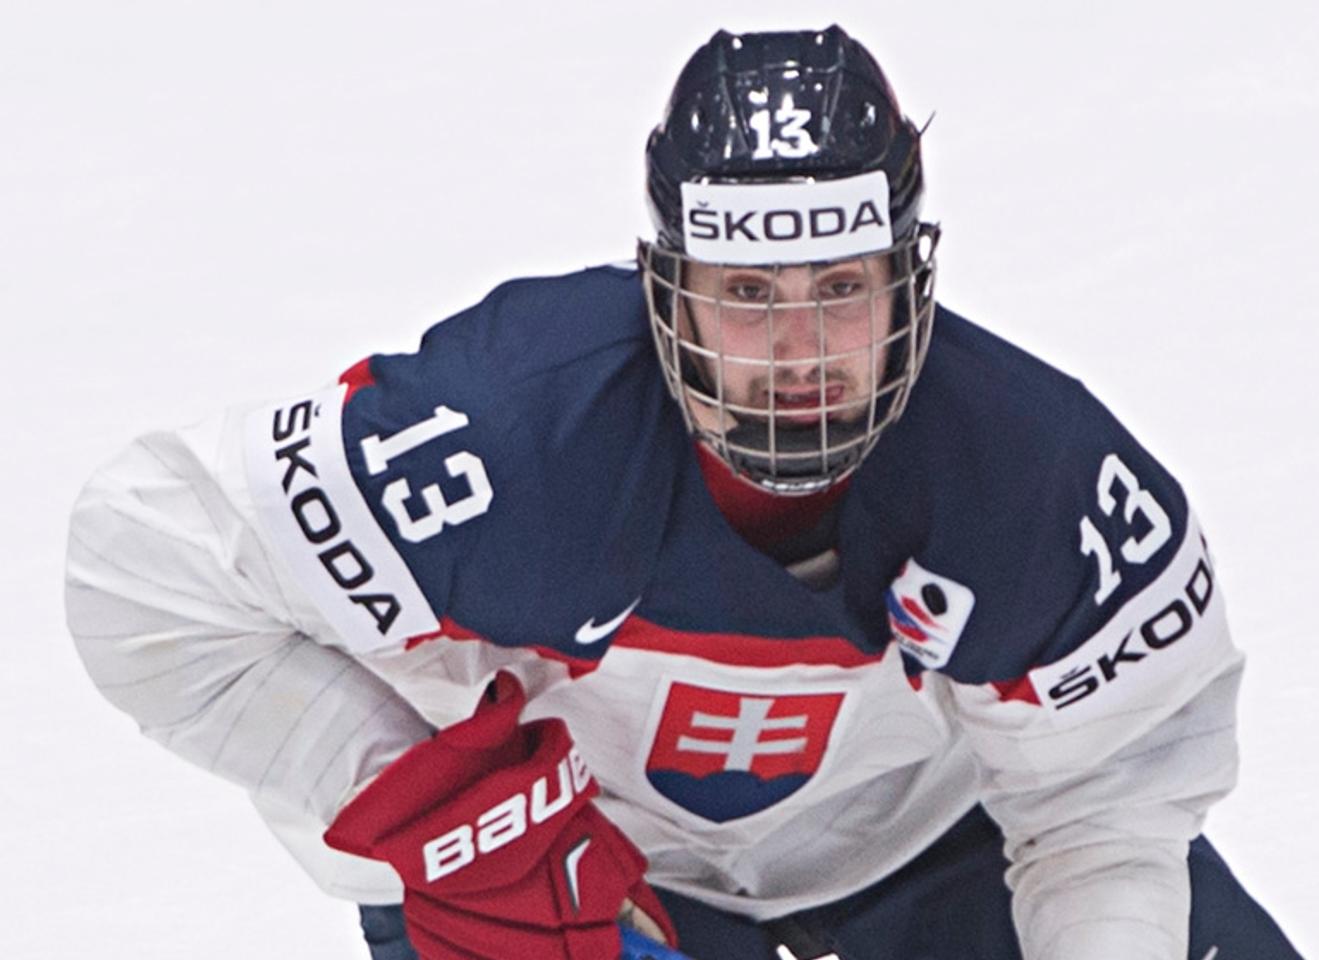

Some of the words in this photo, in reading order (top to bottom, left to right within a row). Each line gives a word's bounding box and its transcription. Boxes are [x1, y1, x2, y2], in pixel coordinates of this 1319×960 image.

[750, 106, 817, 160] 13
[688, 200, 885, 242] ŠKODA
[272, 399, 402, 637] ŠKODA
[360, 405, 494, 543] 13
[1079, 453, 1172, 606] 13
[1048, 534, 1214, 711] ŠKOD
[422, 750, 594, 884] BAUE
